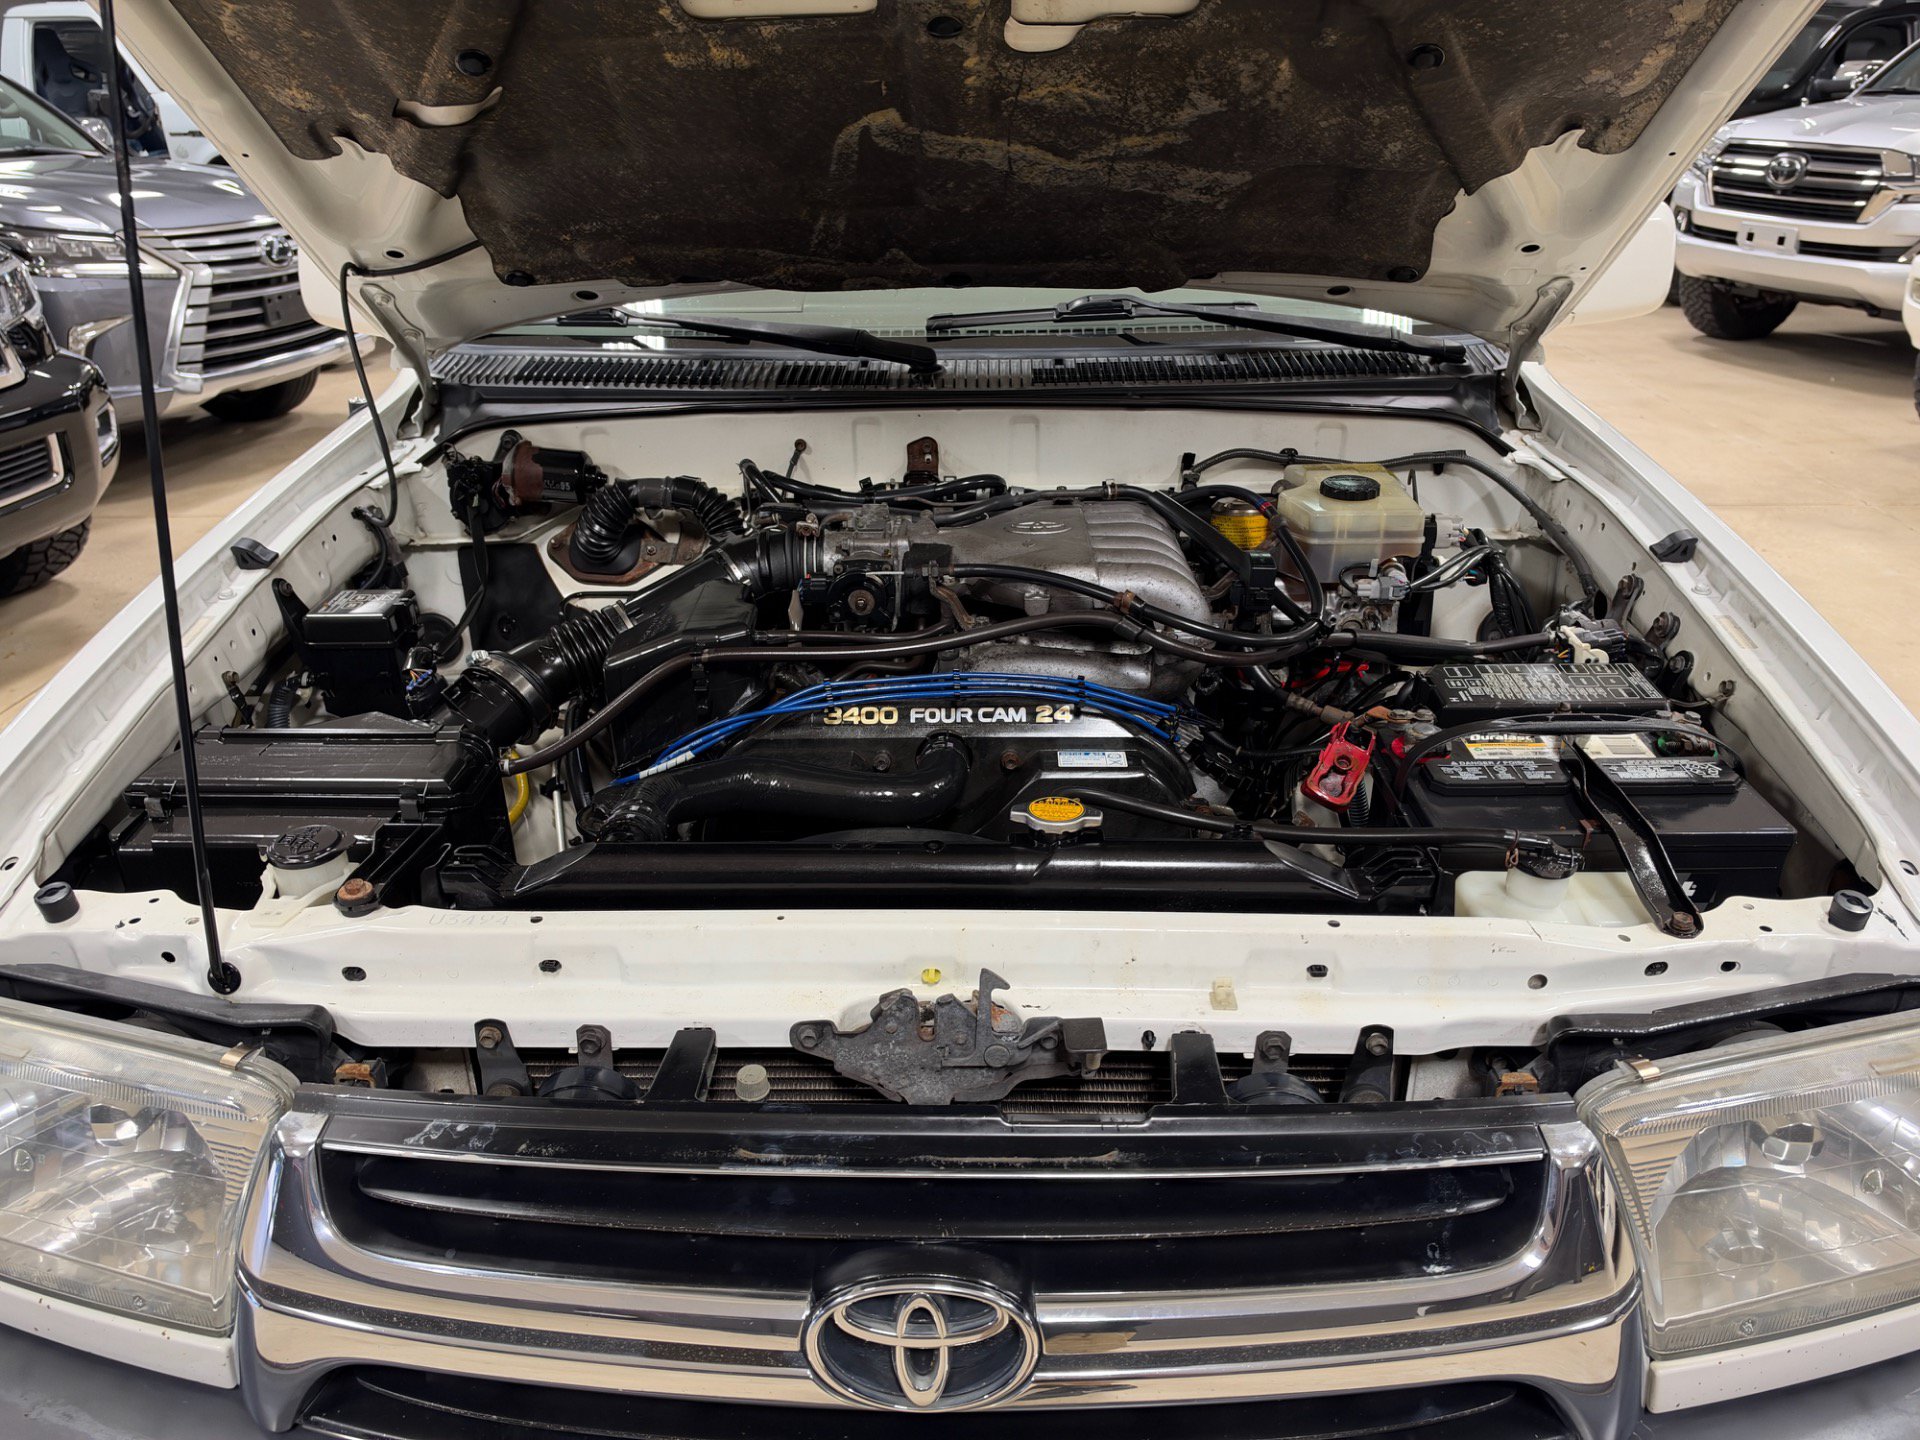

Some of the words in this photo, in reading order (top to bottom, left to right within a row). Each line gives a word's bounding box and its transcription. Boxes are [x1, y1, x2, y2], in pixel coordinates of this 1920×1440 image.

[823, 706, 898, 725] 3400
[910, 707, 973, 723] FOUR
[978, 707, 1026, 723] CAM
[1035, 705, 1073, 723] 24
